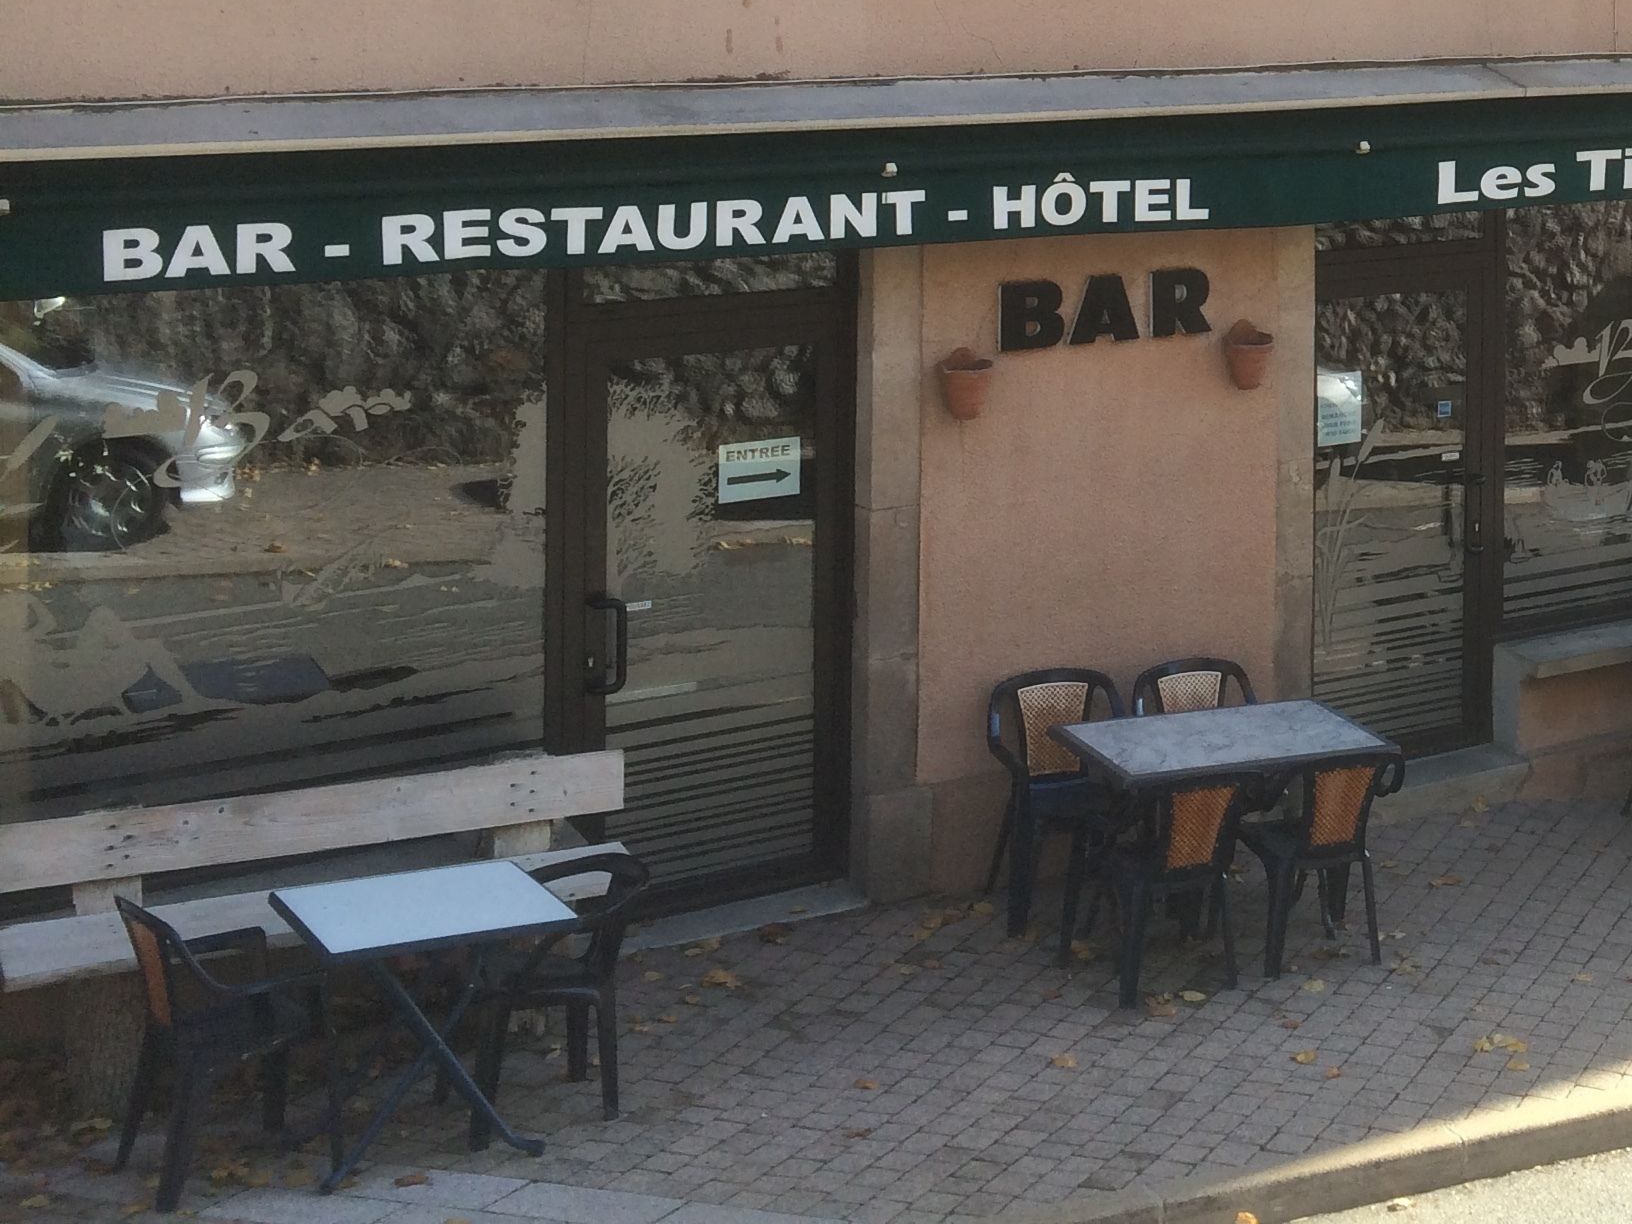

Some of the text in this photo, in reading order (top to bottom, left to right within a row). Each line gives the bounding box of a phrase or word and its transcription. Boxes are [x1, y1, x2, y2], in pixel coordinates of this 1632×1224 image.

[1437, 159, 1556, 205] Les
[102, 222, 296, 282] BAR
[381, 189, 926, 266] RESTAURANT
[992, 172, 1210, 229] HÔTEL
[998, 267, 1212, 352] BAR
[725, 444, 791, 462] ENTREE
